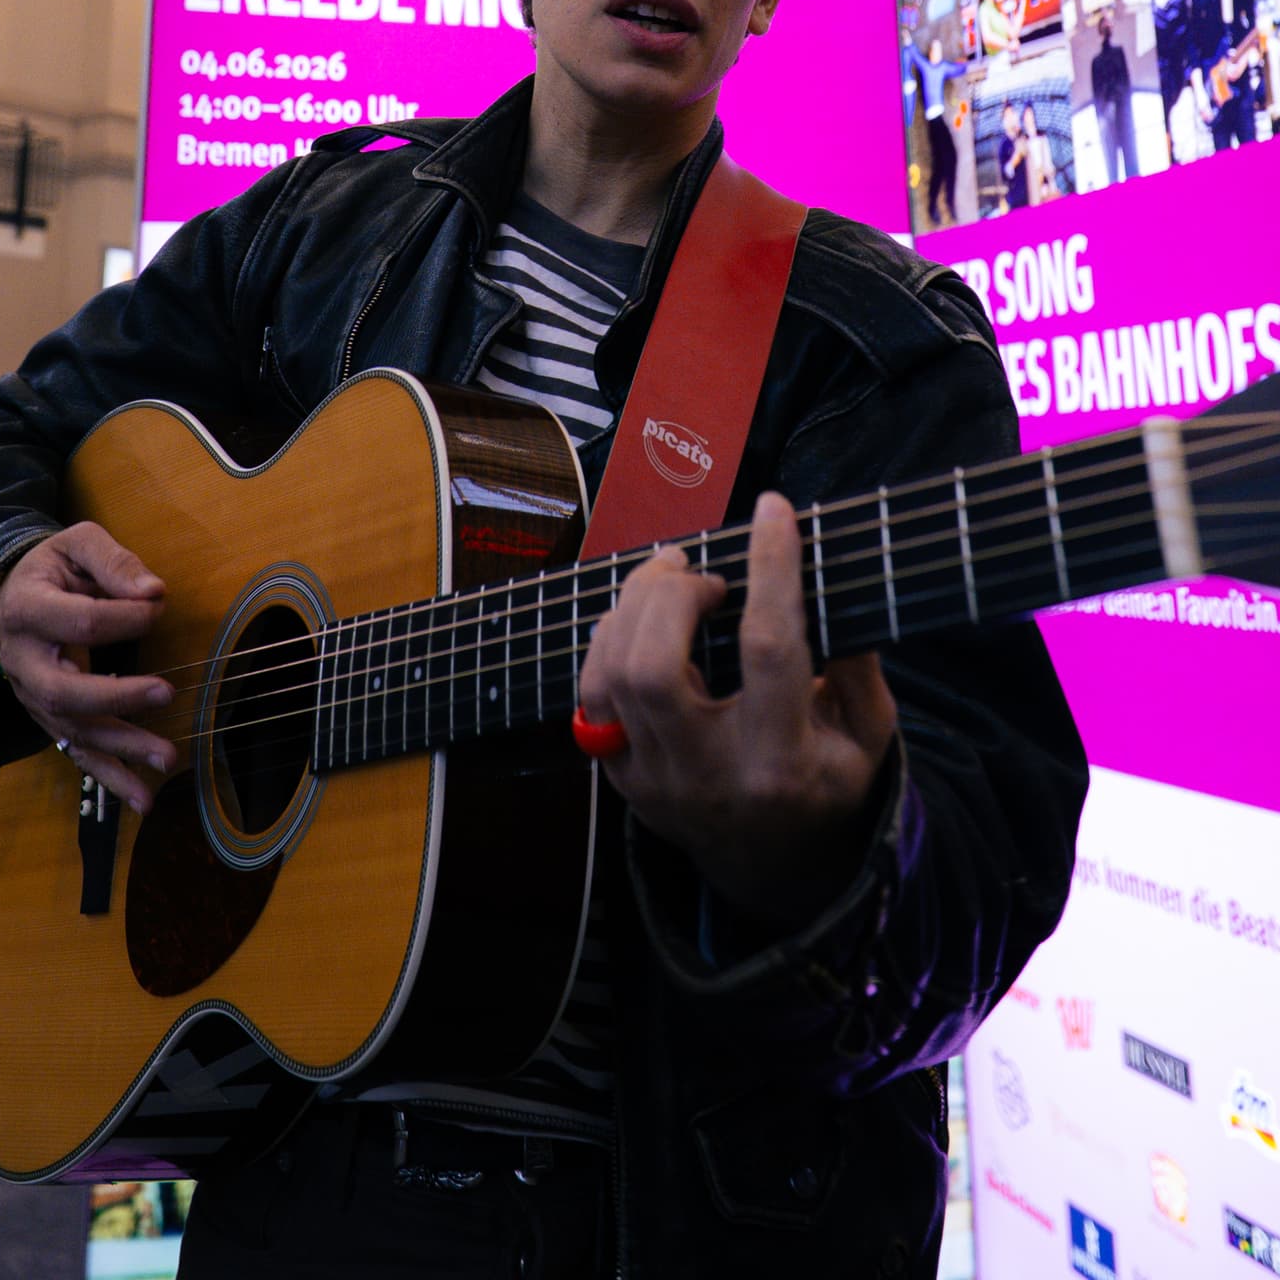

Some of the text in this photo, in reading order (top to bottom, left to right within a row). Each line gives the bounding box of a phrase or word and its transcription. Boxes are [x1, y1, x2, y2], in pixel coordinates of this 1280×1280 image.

[180, 48, 348, 82] 04.06.2026
[367, 95, 420, 124] Uhr
[177, 133, 288, 168] Bremen
[994, 233, 1096, 326] SONG
[642, 417, 714, 471] picato
[1189, 888, 1223, 932] die
